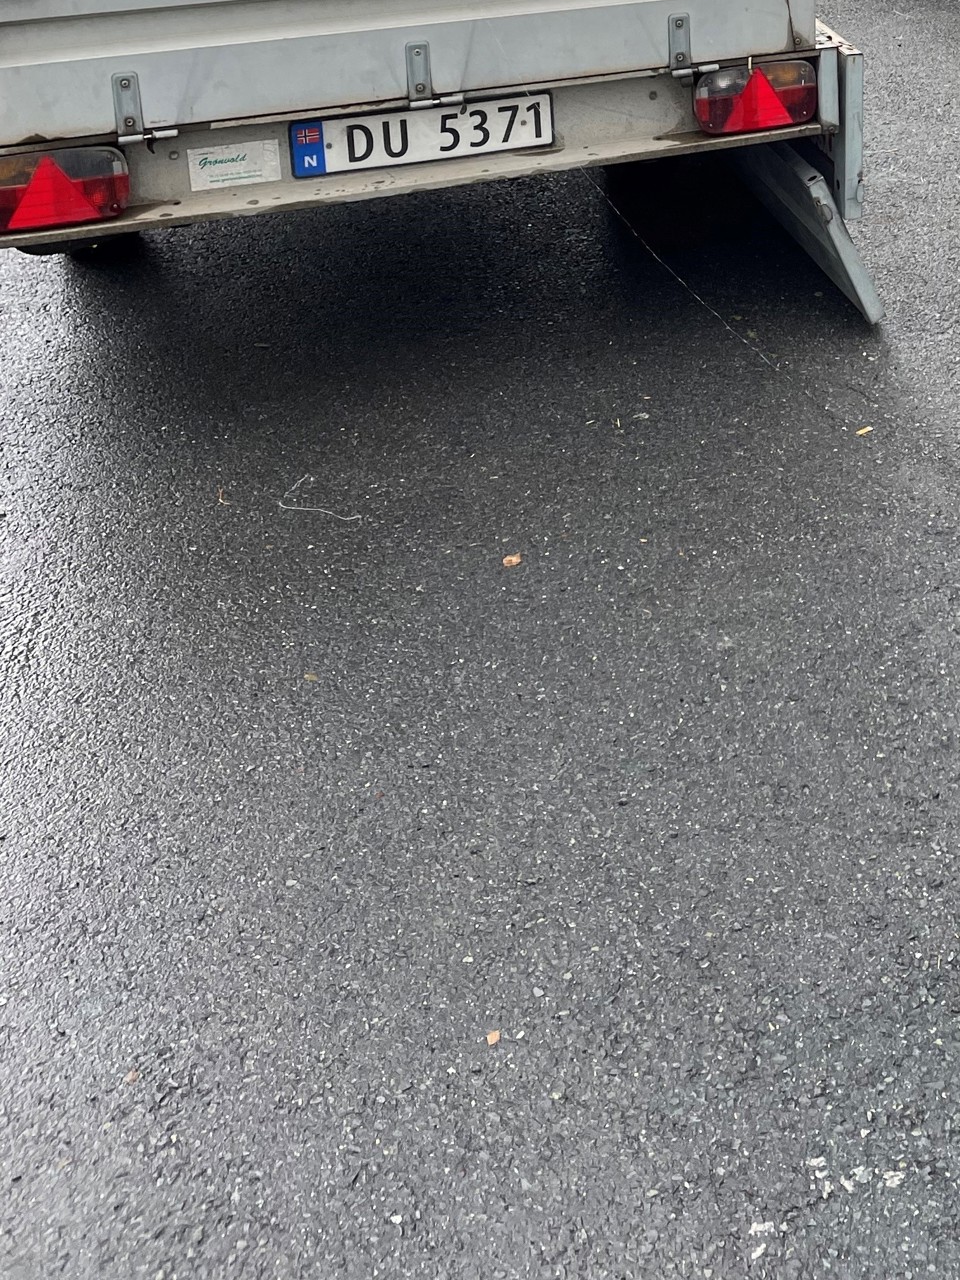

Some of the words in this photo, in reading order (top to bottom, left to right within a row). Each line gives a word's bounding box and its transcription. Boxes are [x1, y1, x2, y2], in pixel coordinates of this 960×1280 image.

[346, 116, 410, 163] DU
[438, 102, 545, 153] 5371
[304, 154, 318, 169] N
